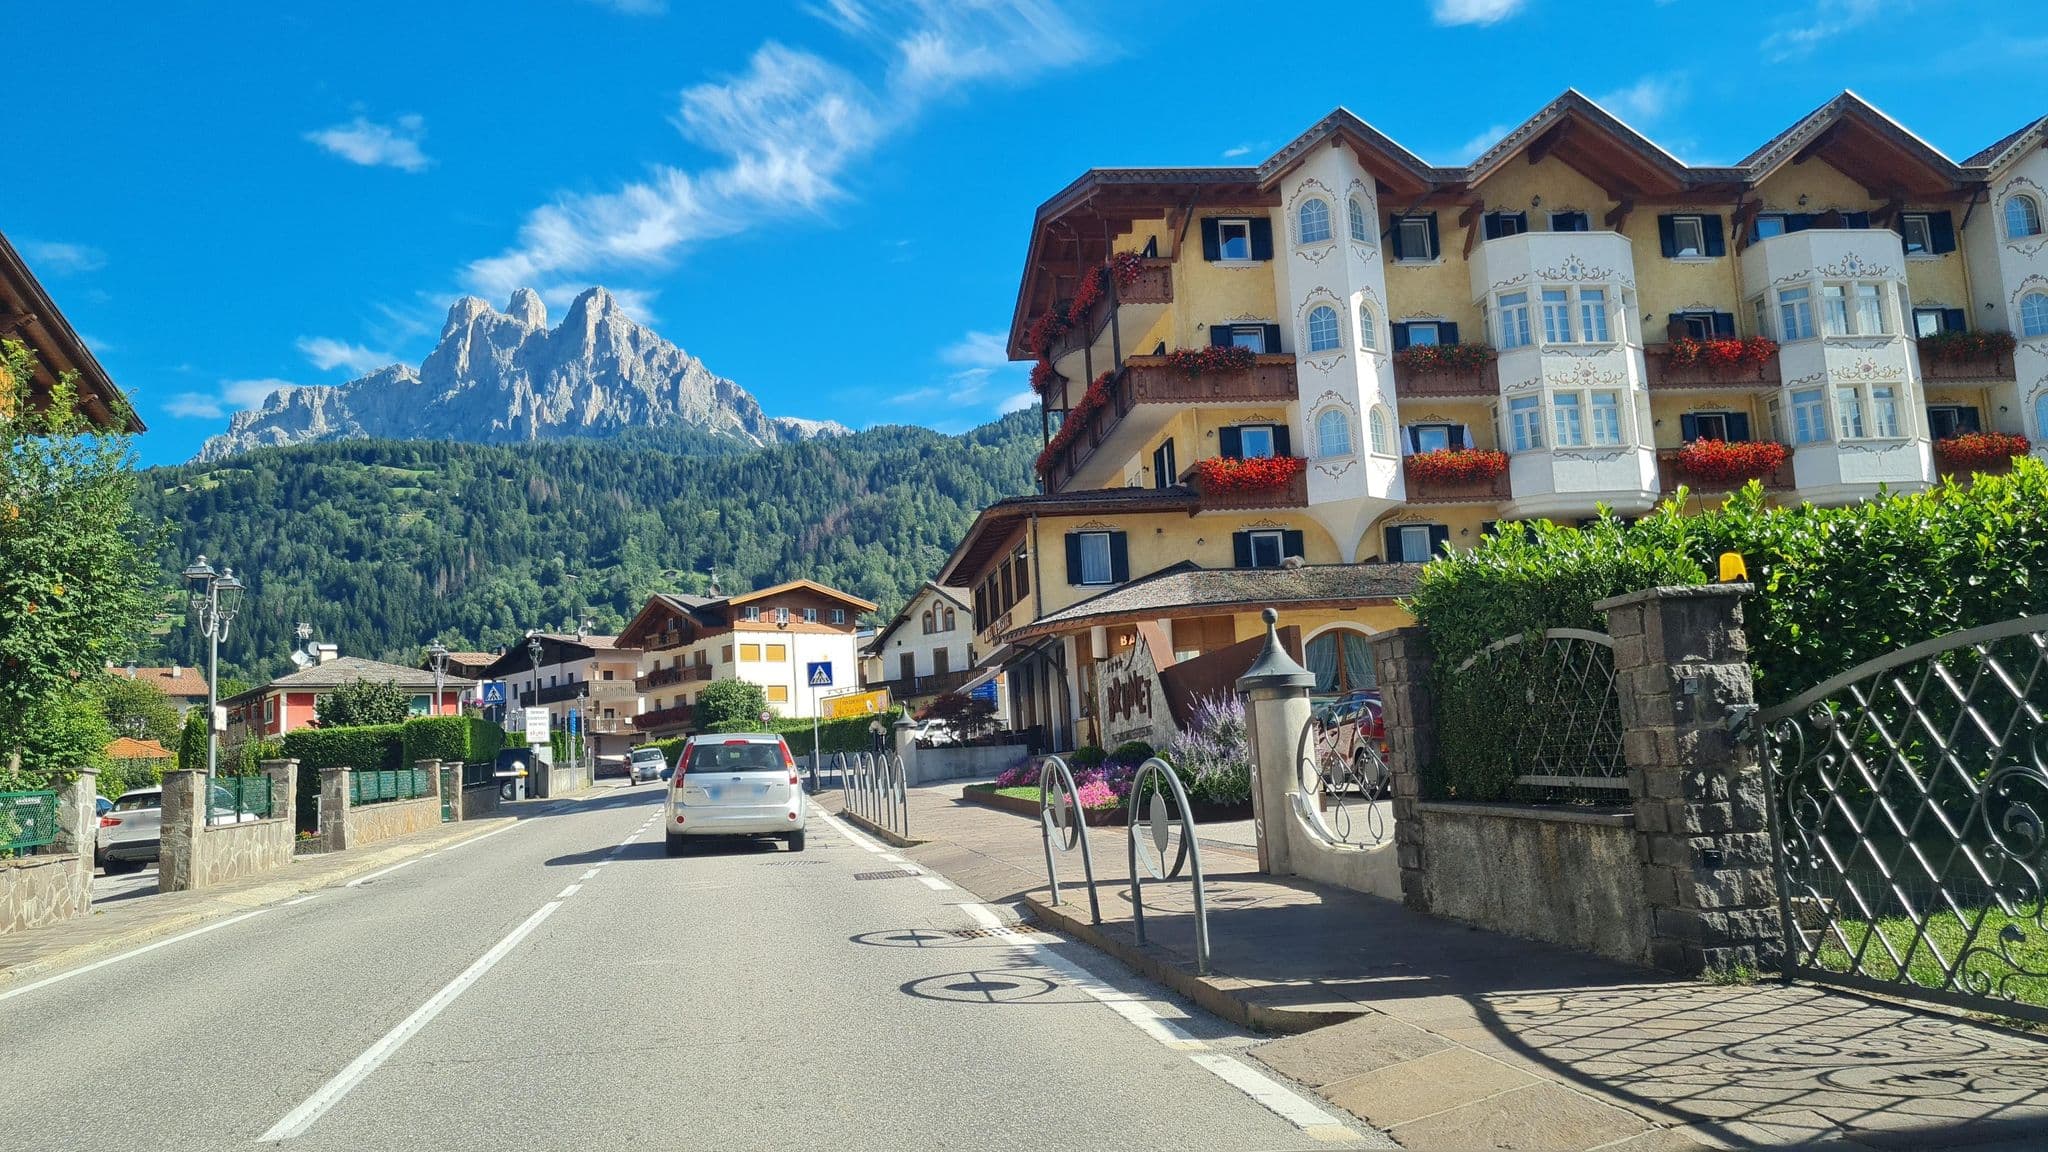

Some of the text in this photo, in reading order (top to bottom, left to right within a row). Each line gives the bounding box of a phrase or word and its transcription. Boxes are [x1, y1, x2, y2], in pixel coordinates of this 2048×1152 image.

[1120, 635, 1136, 646] BA
[1107, 670, 1152, 722] BRUNET
[1249, 737, 1264, 839] IRIS
